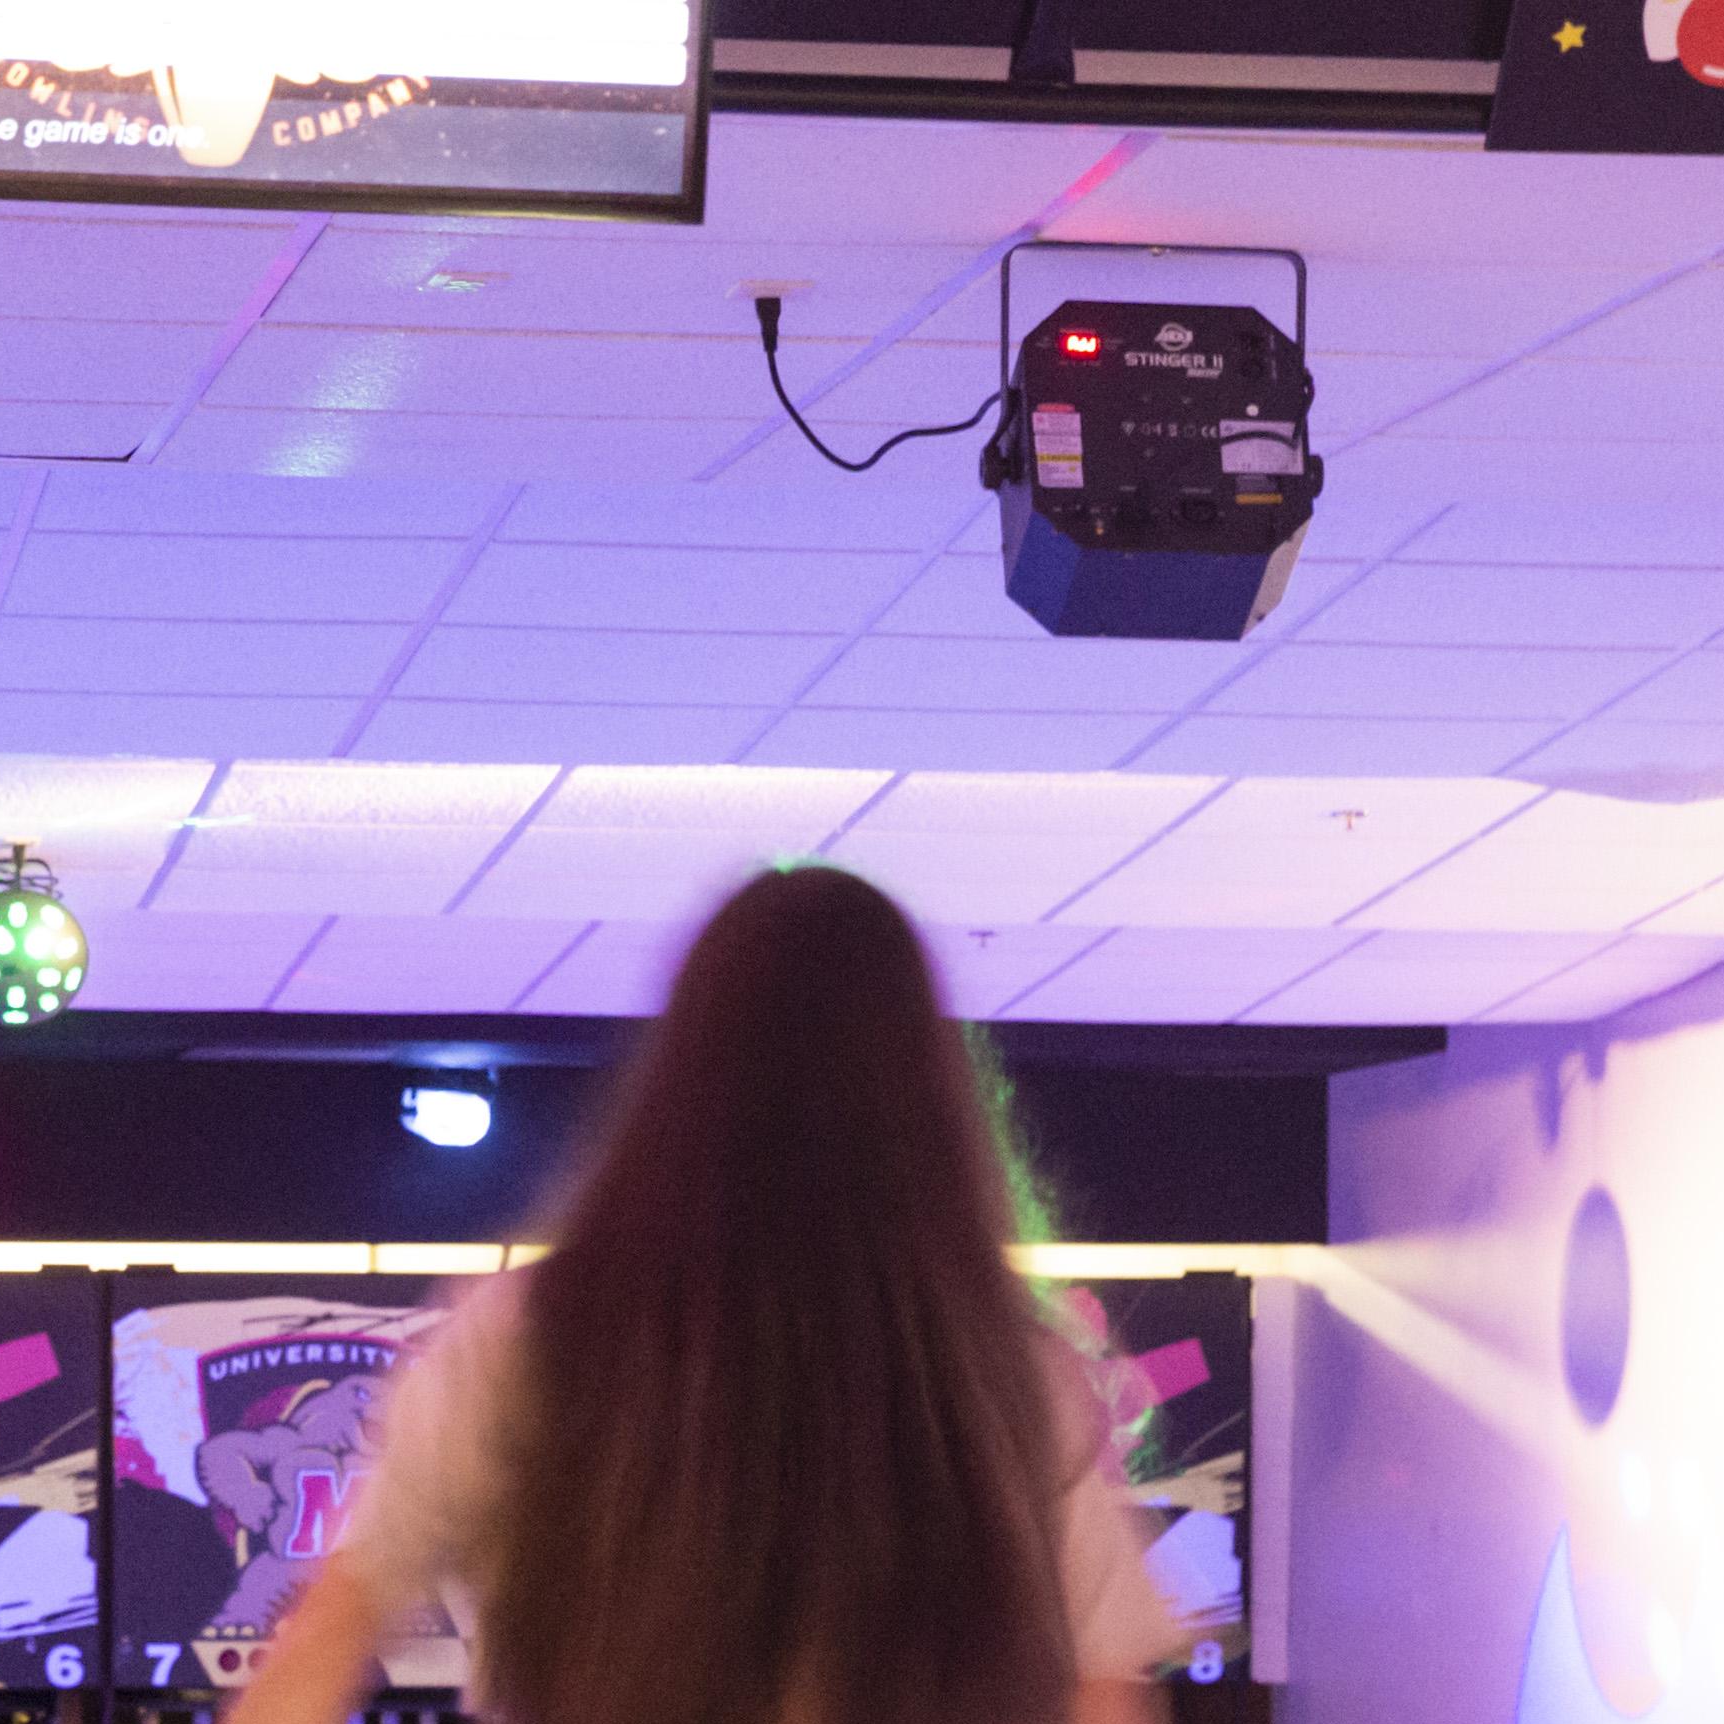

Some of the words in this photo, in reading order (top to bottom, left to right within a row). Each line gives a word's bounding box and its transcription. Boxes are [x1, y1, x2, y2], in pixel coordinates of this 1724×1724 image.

[23, 118, 108, 149] game
[115, 118, 143, 145] is
[1124, 352, 1207, 368] STINGER
[45, 1644, 85, 1688] 6
[146, 1643, 180, 1687] 7
[1187, 1640, 1224, 1684] 8
